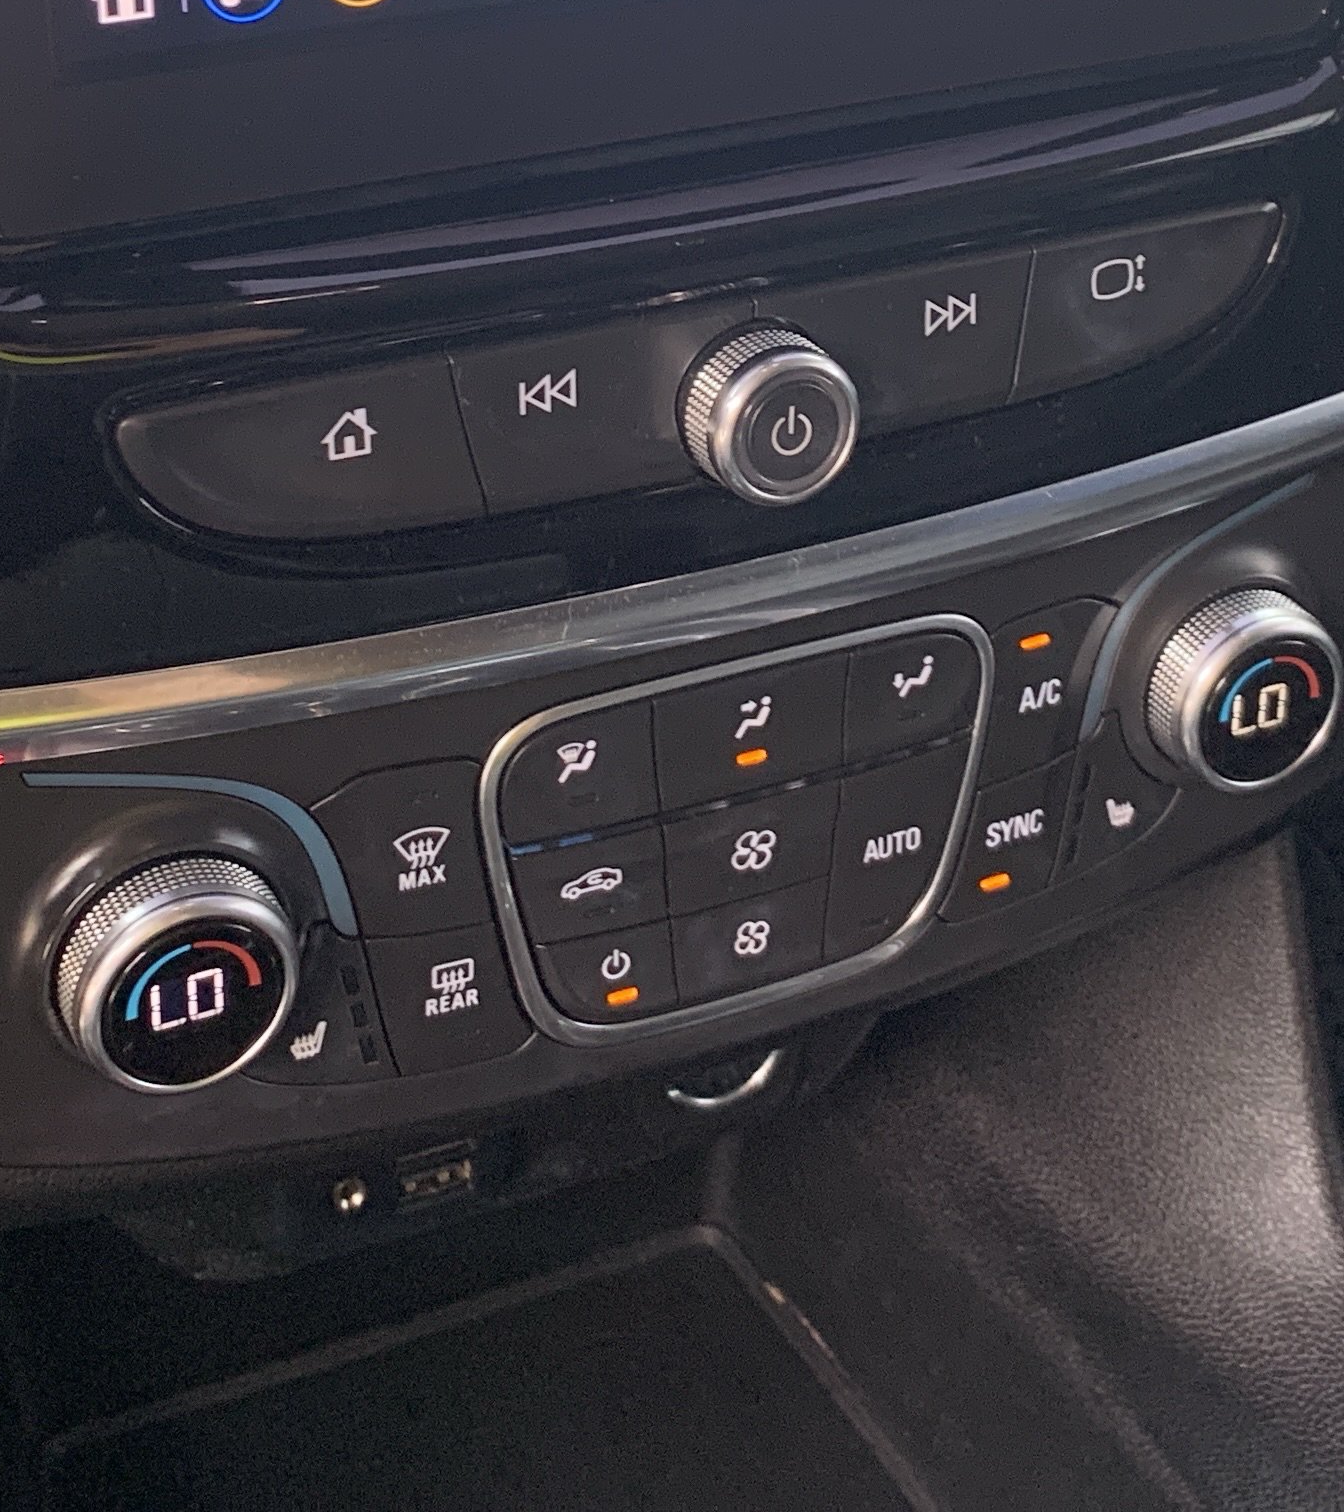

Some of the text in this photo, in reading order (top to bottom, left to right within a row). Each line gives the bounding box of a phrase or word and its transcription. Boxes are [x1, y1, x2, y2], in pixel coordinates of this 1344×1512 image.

[1018, 678, 1062, 714] A/C
[863, 826, 922, 865] AUTO
[985, 808, 1045, 849] SYNC
[398, 864, 448, 892] MAX
[425, 988, 480, 1018] REAR
